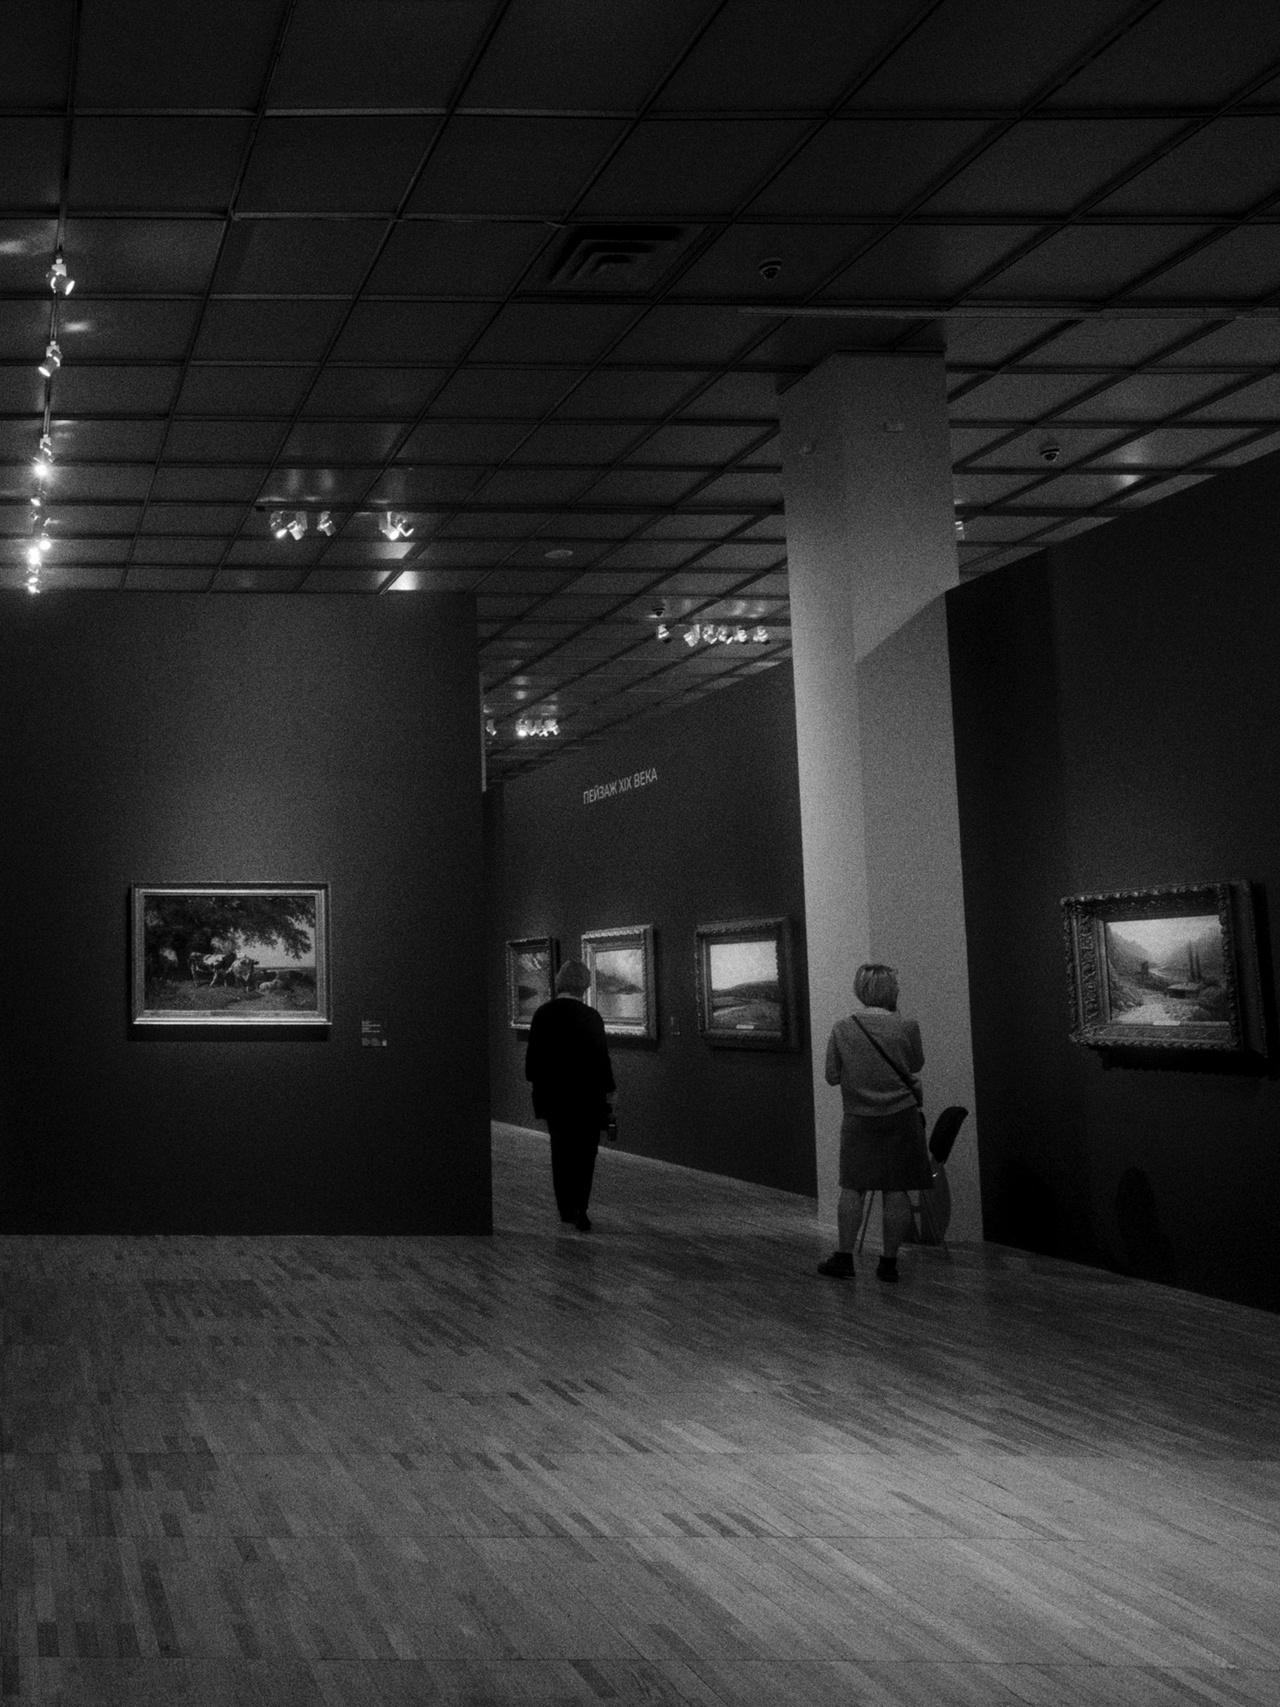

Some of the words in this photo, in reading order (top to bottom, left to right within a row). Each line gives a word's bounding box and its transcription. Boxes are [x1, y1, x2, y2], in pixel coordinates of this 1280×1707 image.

[583, 779, 618, 805] ПЕЙЗАЖ
[618, 775, 633, 793] XIX
[633, 767, 658, 788] ВЕКА
